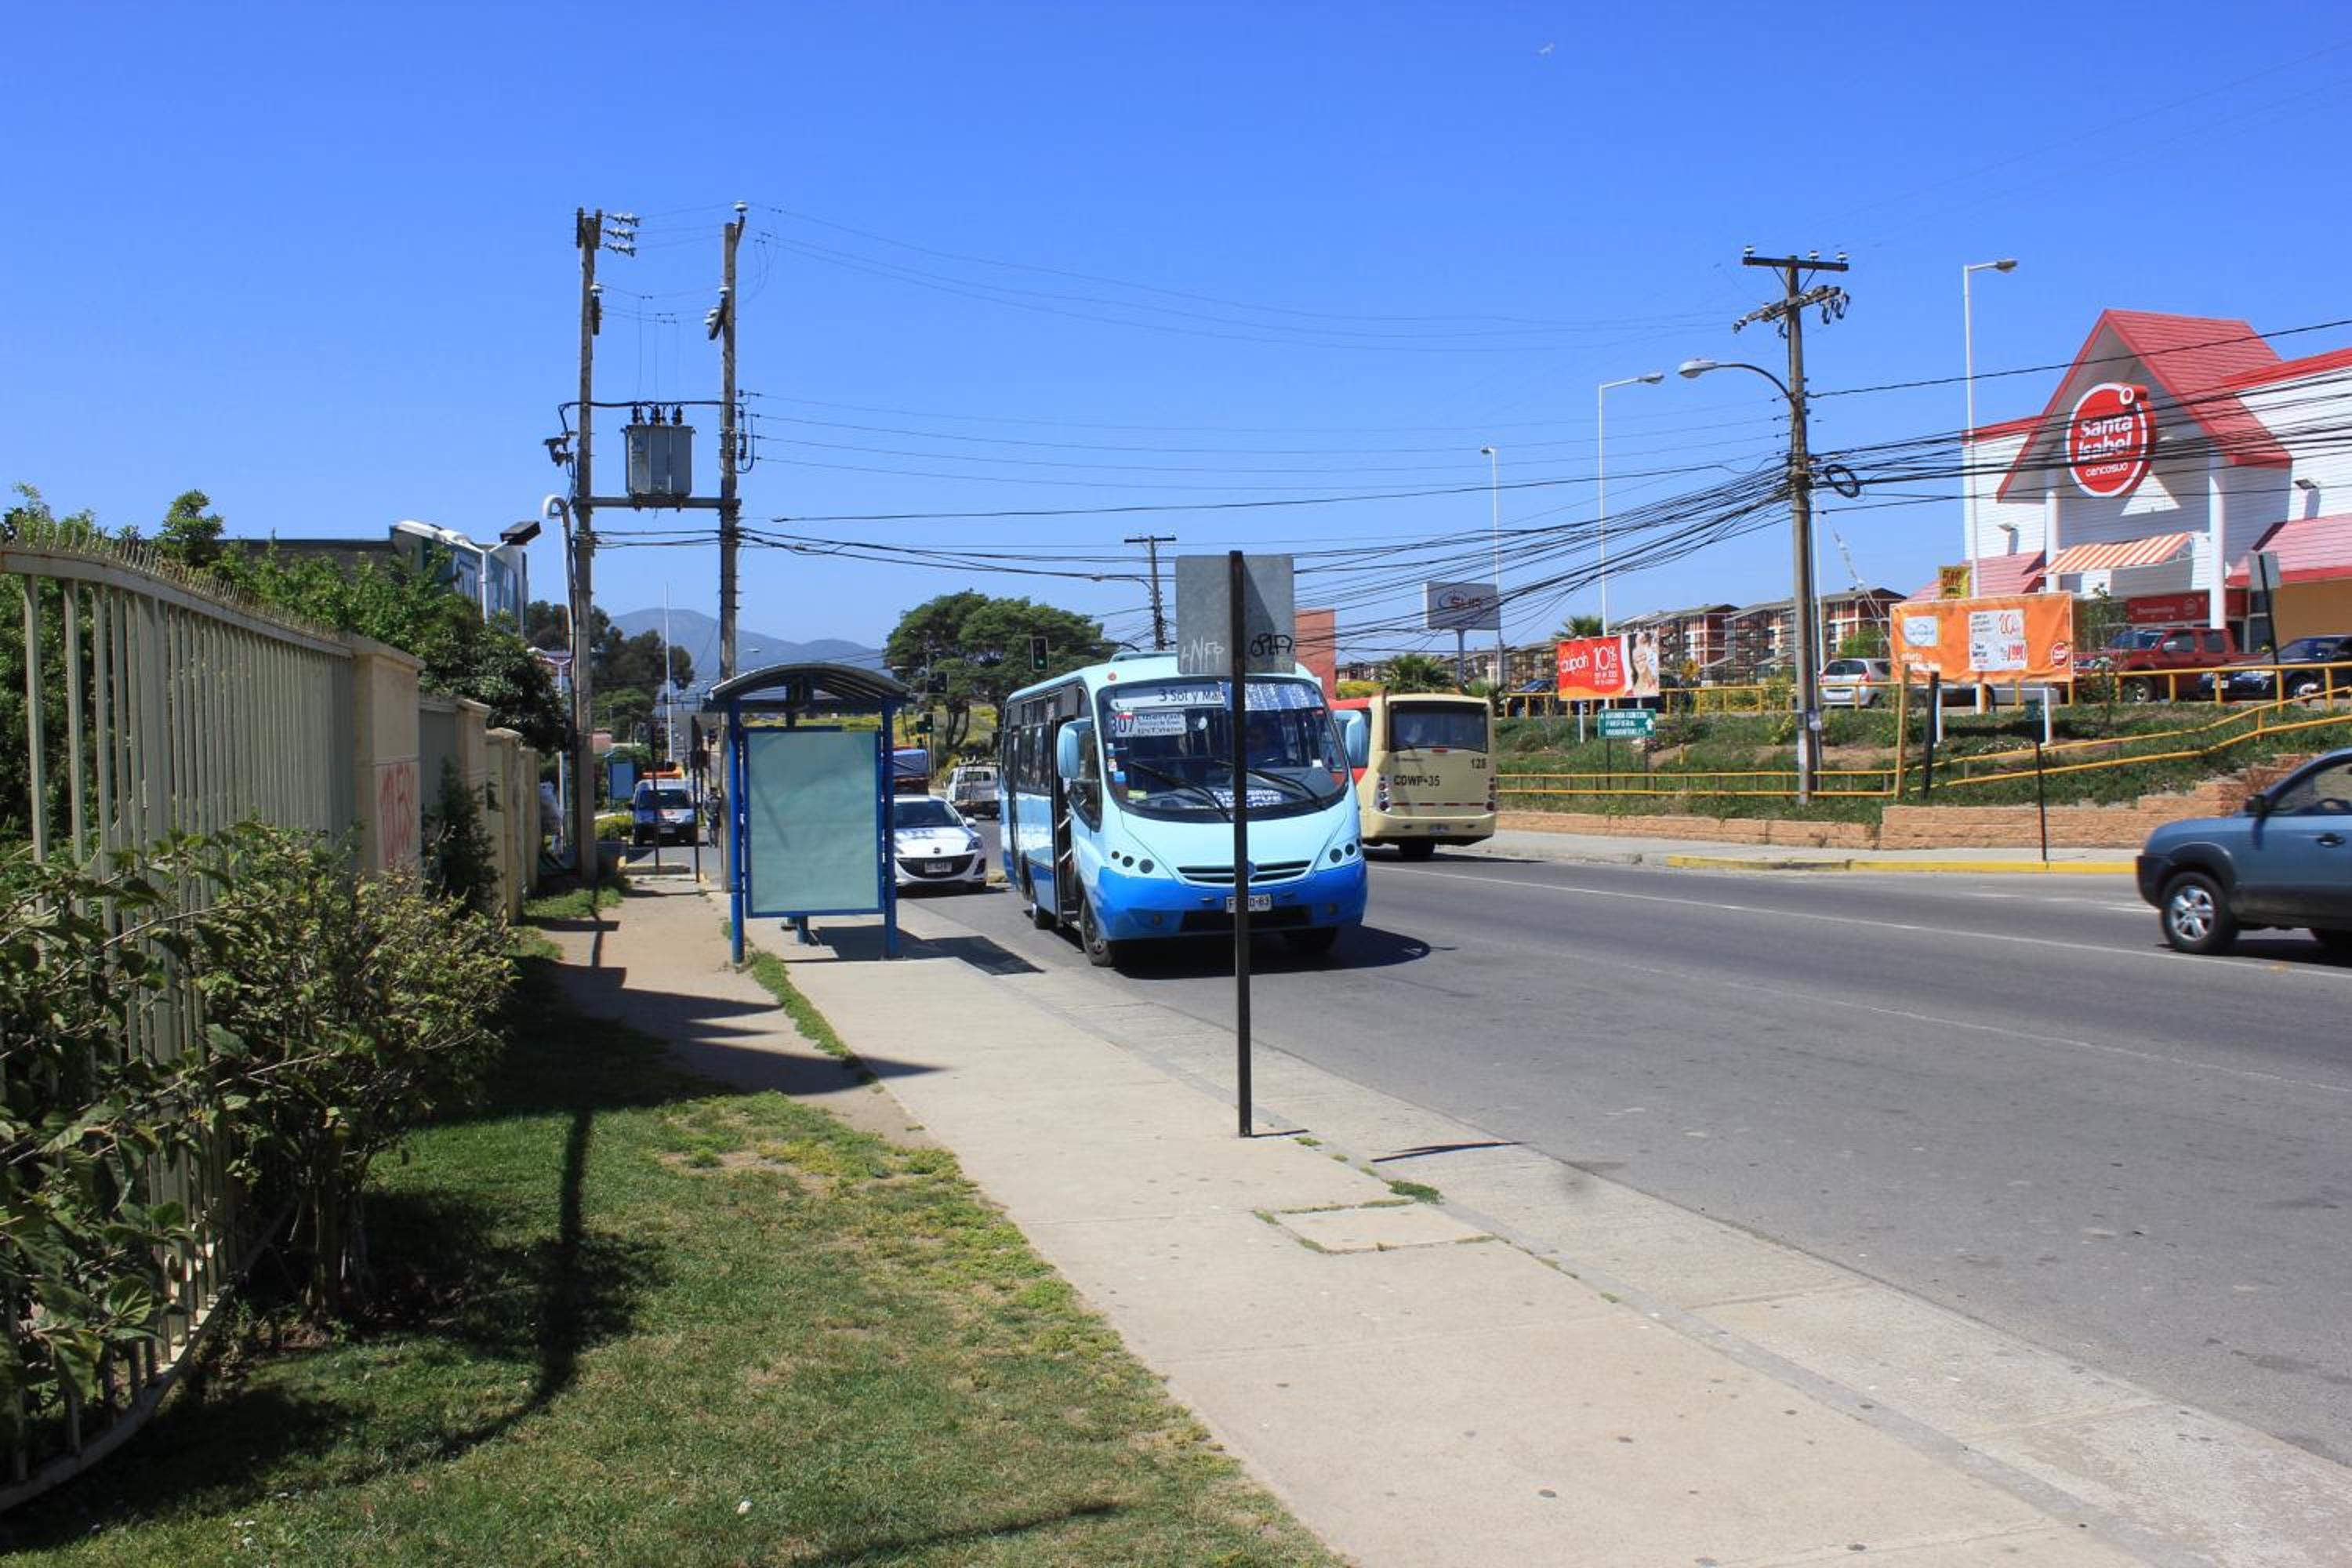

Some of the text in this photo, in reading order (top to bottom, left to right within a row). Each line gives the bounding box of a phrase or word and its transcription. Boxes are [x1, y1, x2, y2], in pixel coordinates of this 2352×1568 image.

[2080, 414, 2133, 437] Santa
[2078, 431, 2132, 461] Isabel
[2085, 461, 2129, 477] cencosud
[1158, 688, 1167, 702] 3
